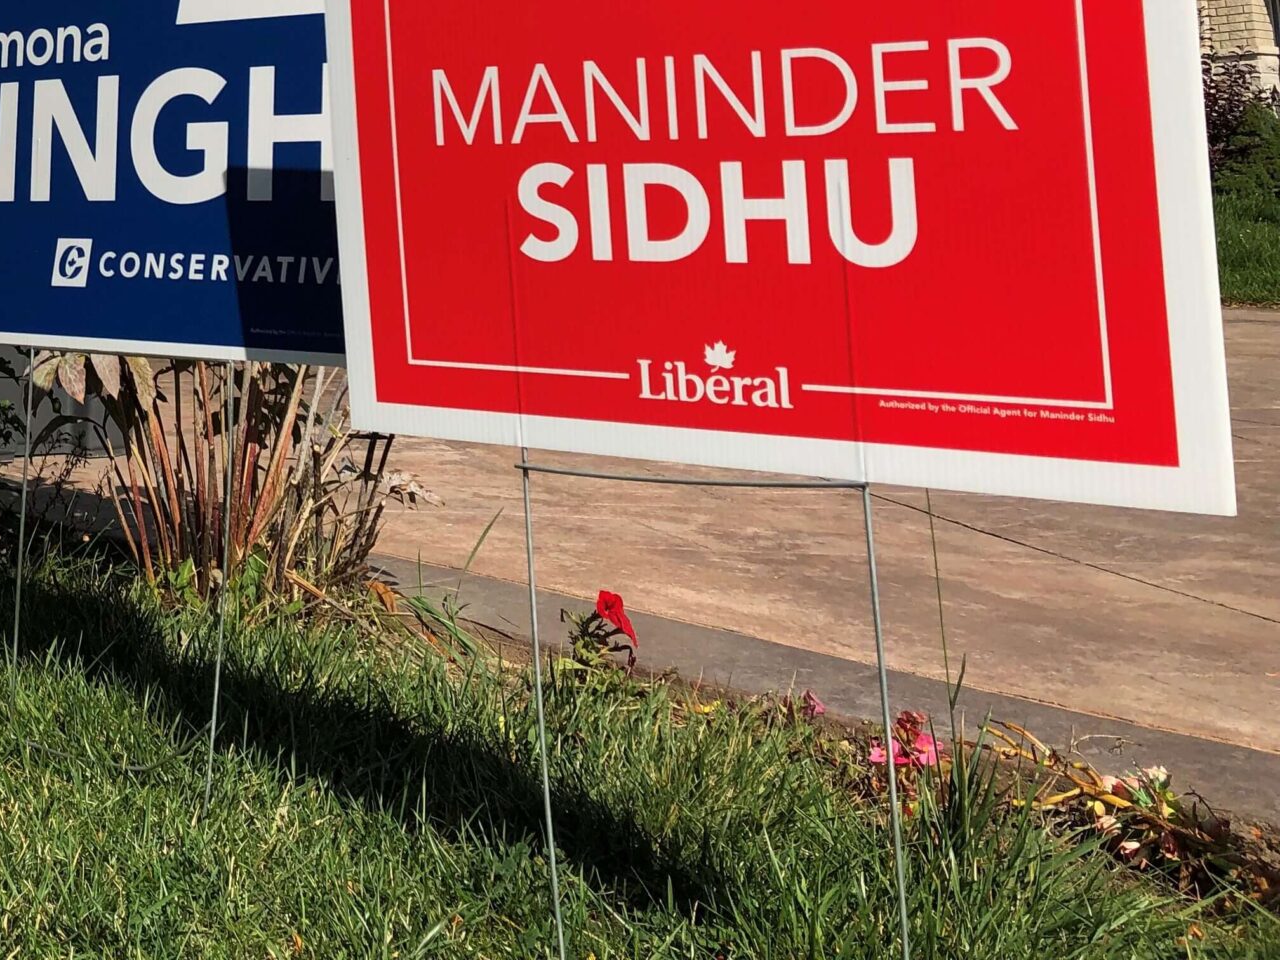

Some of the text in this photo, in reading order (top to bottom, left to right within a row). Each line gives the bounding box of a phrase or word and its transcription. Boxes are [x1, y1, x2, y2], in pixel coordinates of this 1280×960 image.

[431, 37, 1019, 147] MANINDER
[517, 157, 919, 269] SIDHU
[98, 251, 341, 286] CONSERVATIV
[879, 400, 1116, 424] Authorized by the Official Agent for Maninder Sidhu
